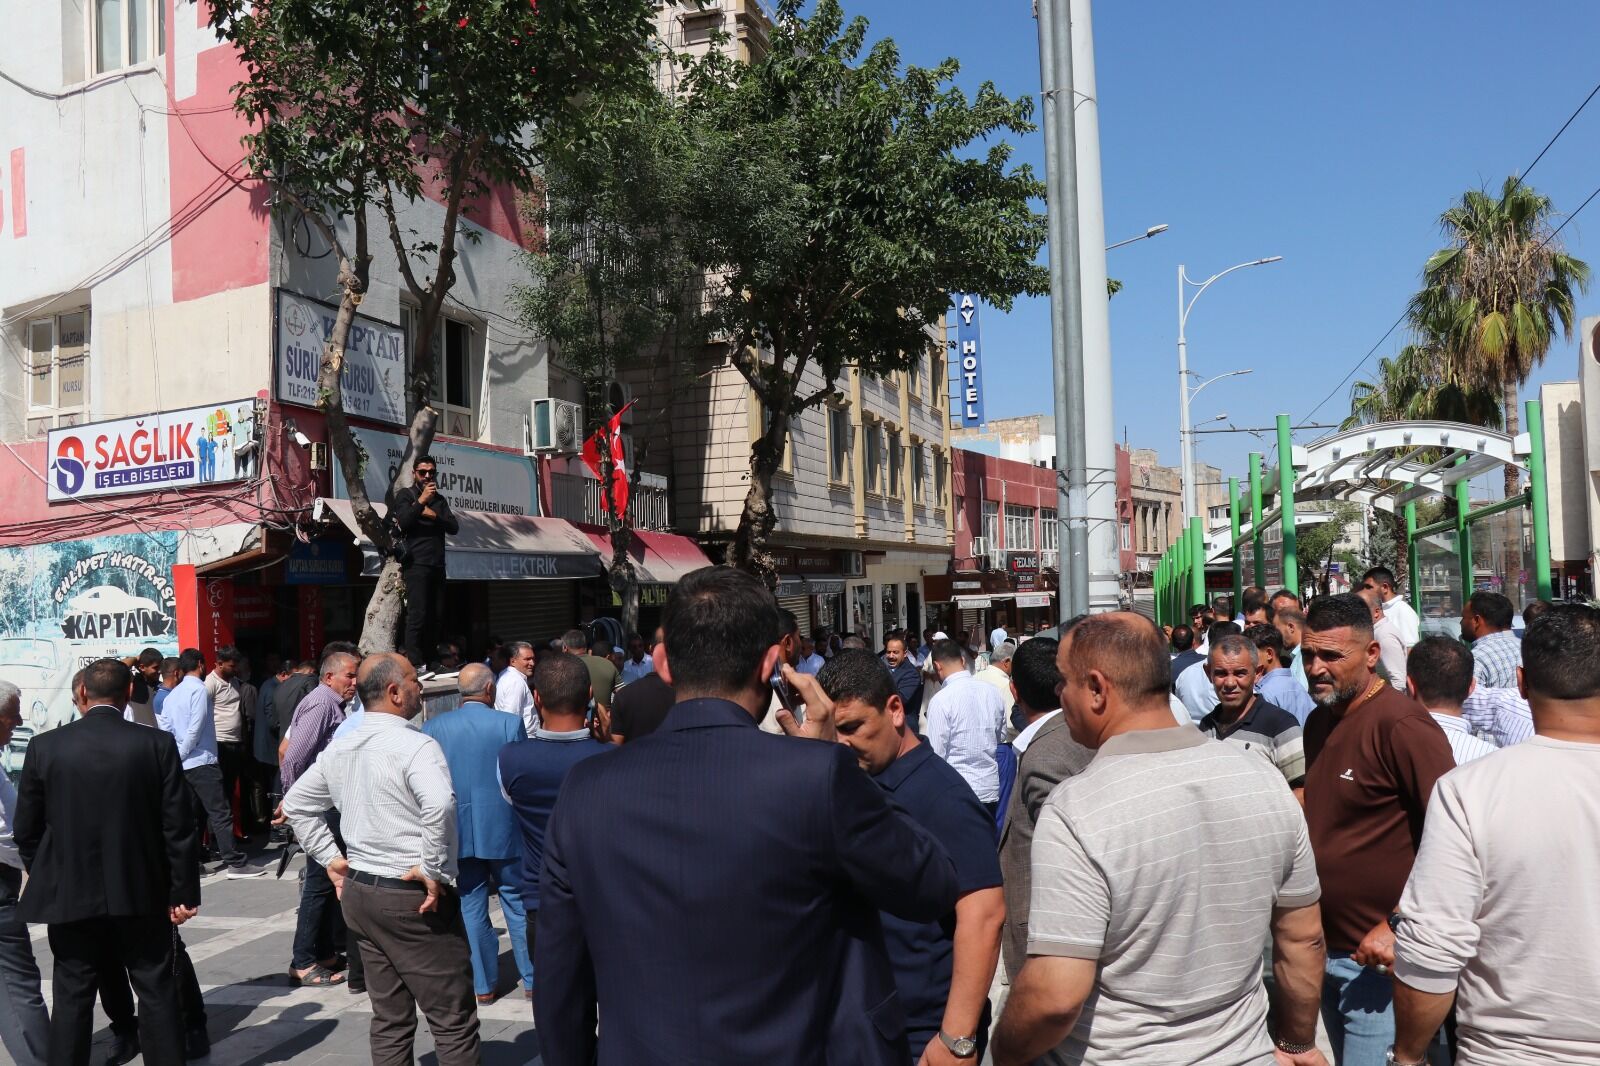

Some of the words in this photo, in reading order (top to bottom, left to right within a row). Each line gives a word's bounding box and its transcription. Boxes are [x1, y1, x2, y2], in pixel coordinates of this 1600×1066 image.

[960, 291, 975, 327] AY
[322, 315, 400, 361] KPTAN
[286, 341, 319, 382] SÜRÜ
[963, 340, 978, 419] HOTEL
[63, 380, 82, 393] KURSU
[94, 420, 195, 470] SAĞLIK
[98, 473, 110, 489] İŞ
[112, 463, 191, 483] ELBİSELERİ
[501, 502, 524, 516] KURSU
[55, 552, 109, 603] EHLİYET
[110, 551, 176, 608] HATIRASI
[492, 554, 558, 575] ELEKTRİK
[68, 611, 159, 639] KAPTAN
